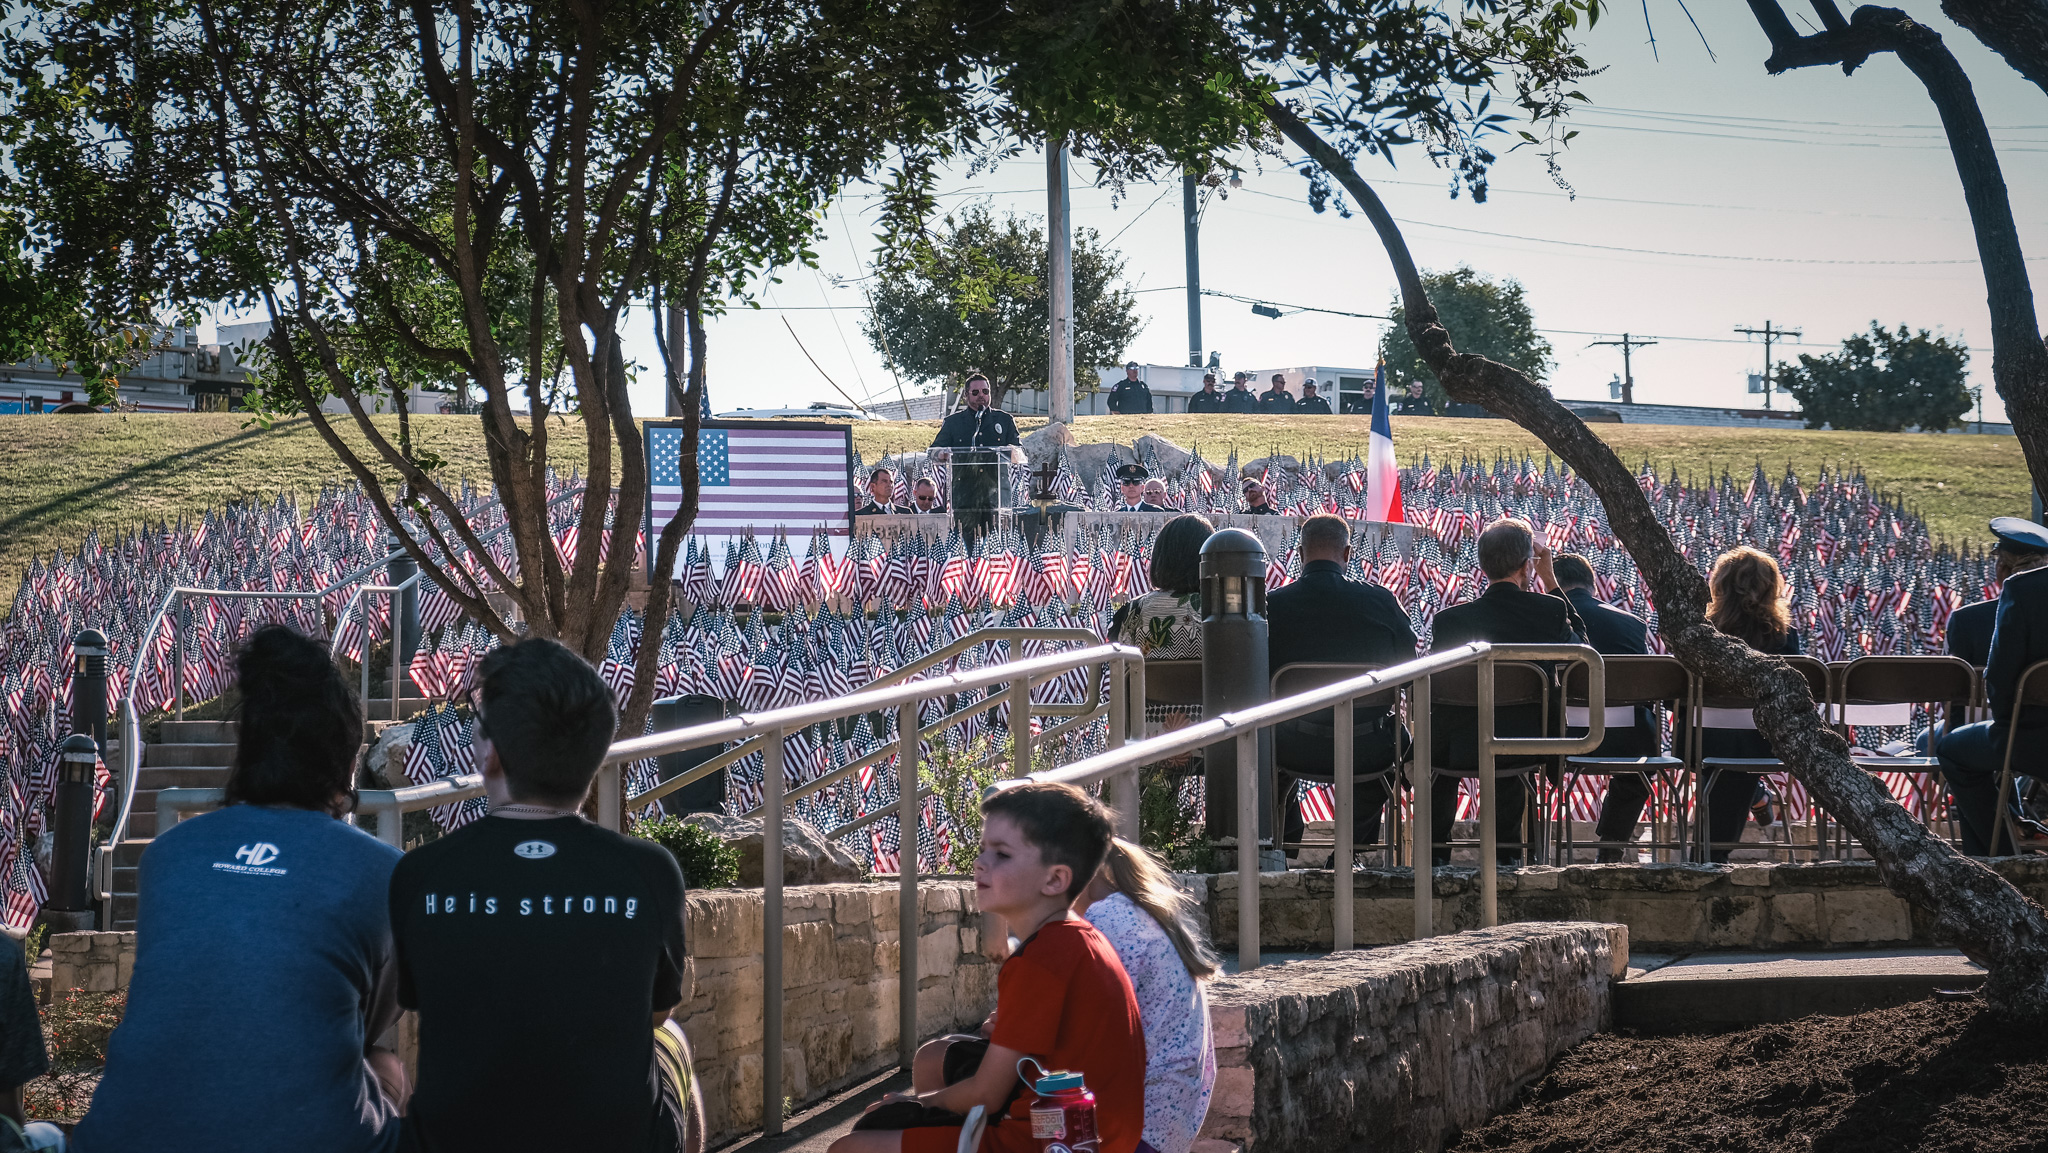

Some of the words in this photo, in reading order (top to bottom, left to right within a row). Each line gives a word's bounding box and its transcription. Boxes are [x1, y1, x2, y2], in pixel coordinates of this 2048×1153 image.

[212, 862, 248, 871] HOWARD
[248, 866, 287, 875] COLLEGE
[425, 893, 456, 915] He
[468, 893, 499, 915] is
[519, 894, 639, 919] strong
